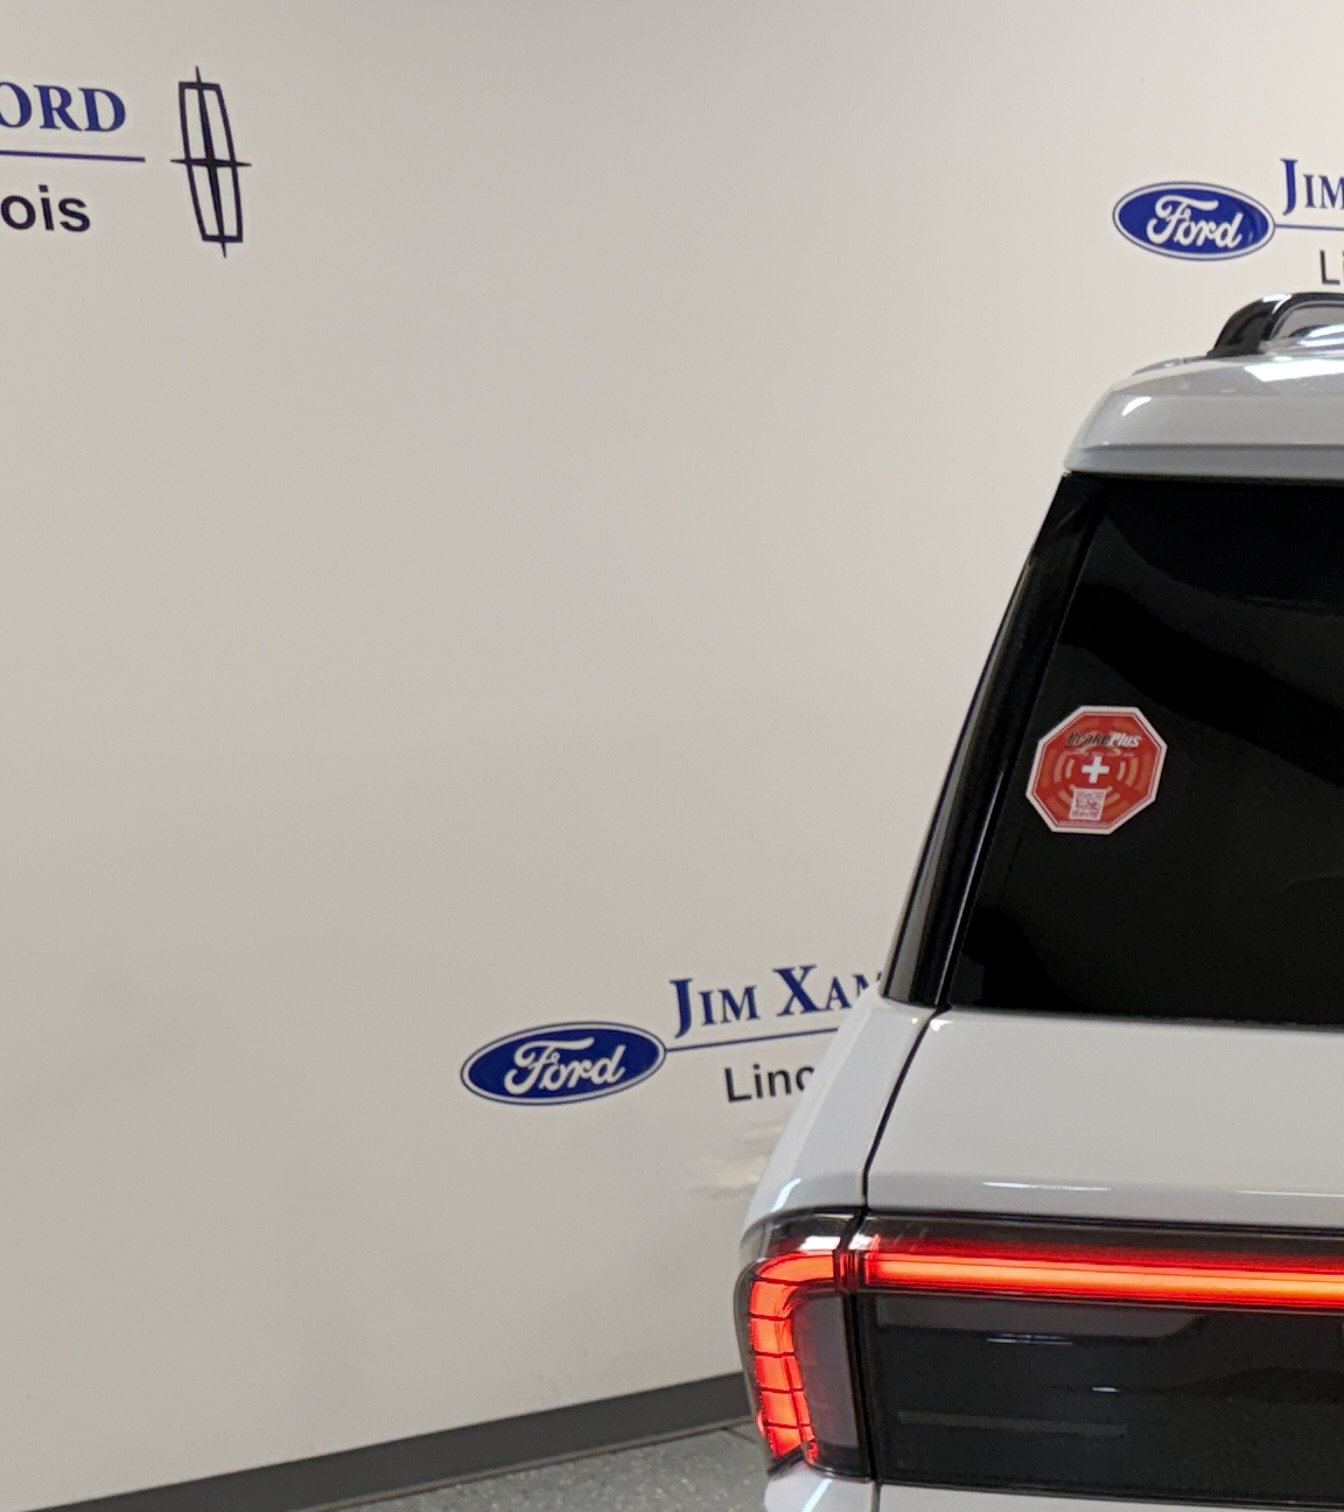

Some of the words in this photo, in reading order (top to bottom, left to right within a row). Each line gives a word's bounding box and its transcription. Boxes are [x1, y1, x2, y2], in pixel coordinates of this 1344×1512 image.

[0, 81, 126, 132] ORD
[1146, 194, 1243, 250] Ford
[669, 978, 760, 1039] JIM
[504, 1036, 627, 1095] Ford
